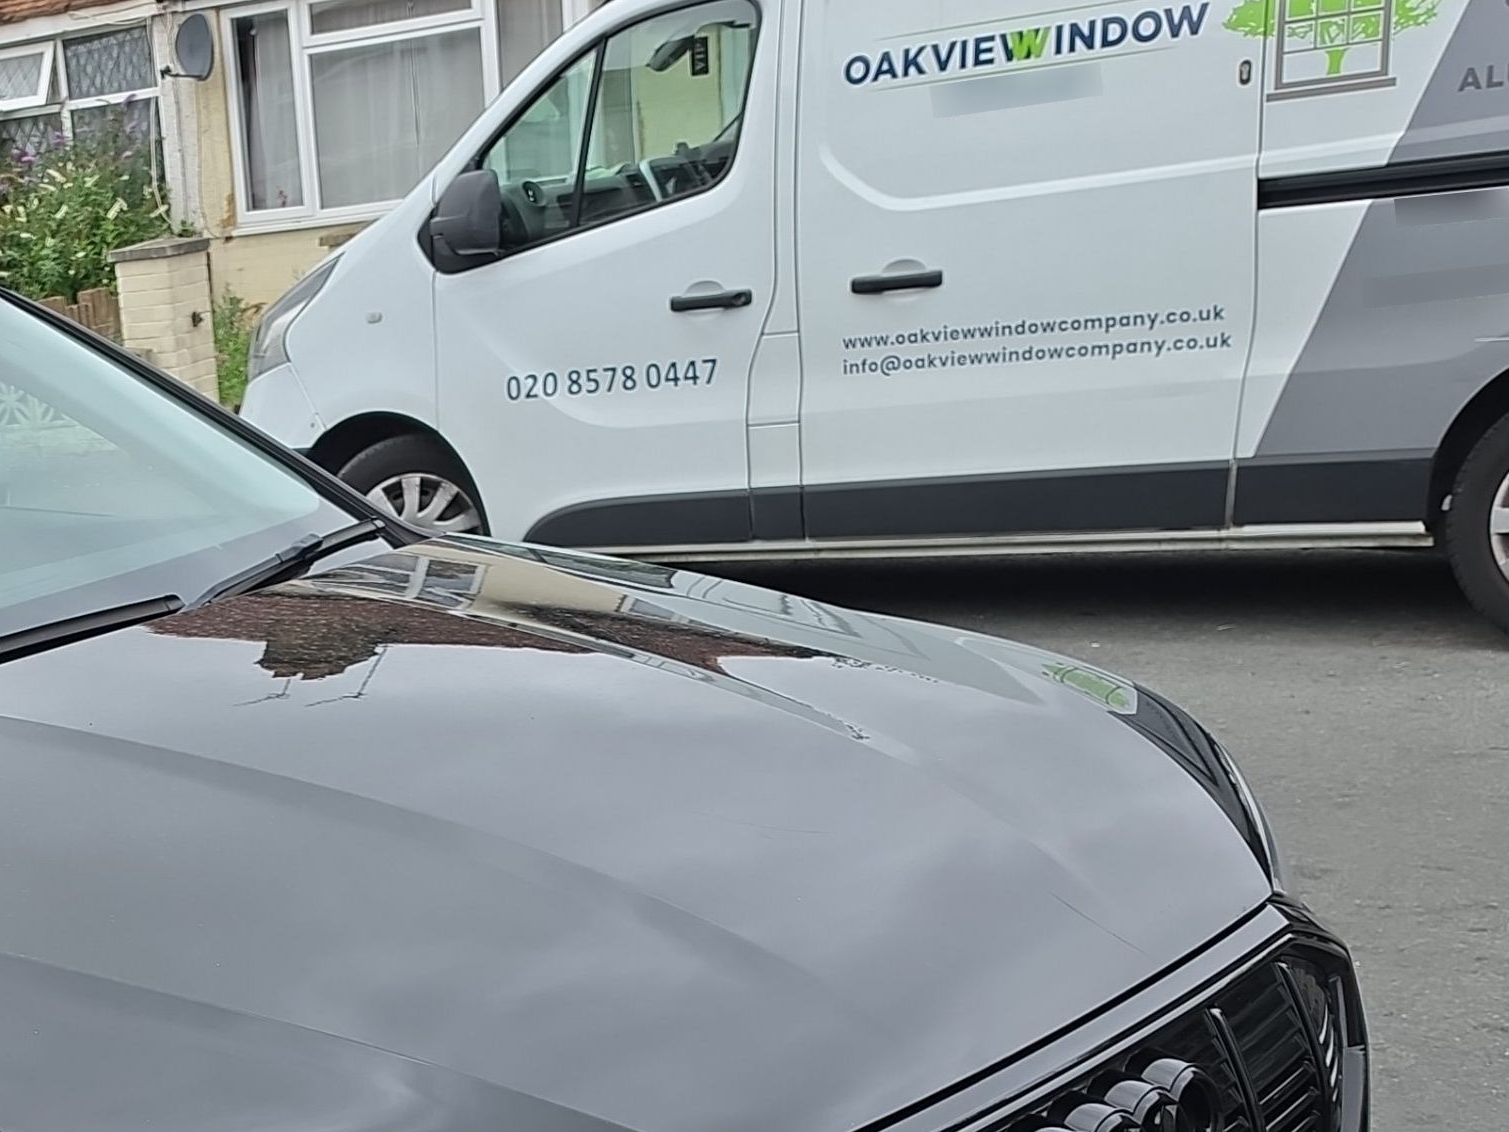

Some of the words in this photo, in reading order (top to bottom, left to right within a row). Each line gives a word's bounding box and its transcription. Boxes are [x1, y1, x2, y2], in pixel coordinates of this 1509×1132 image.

[1457, 62, 1509, 92] AL
[842, 304, 1226, 350] www.oakviewwindowcompany.co.uk
[842, 332, 1232, 377] info@oakviewwindowcompany.co.uk
[506, 371, 559, 401] 020
[566, 364, 638, 396] 8578
[645, 358, 718, 389] 0447
